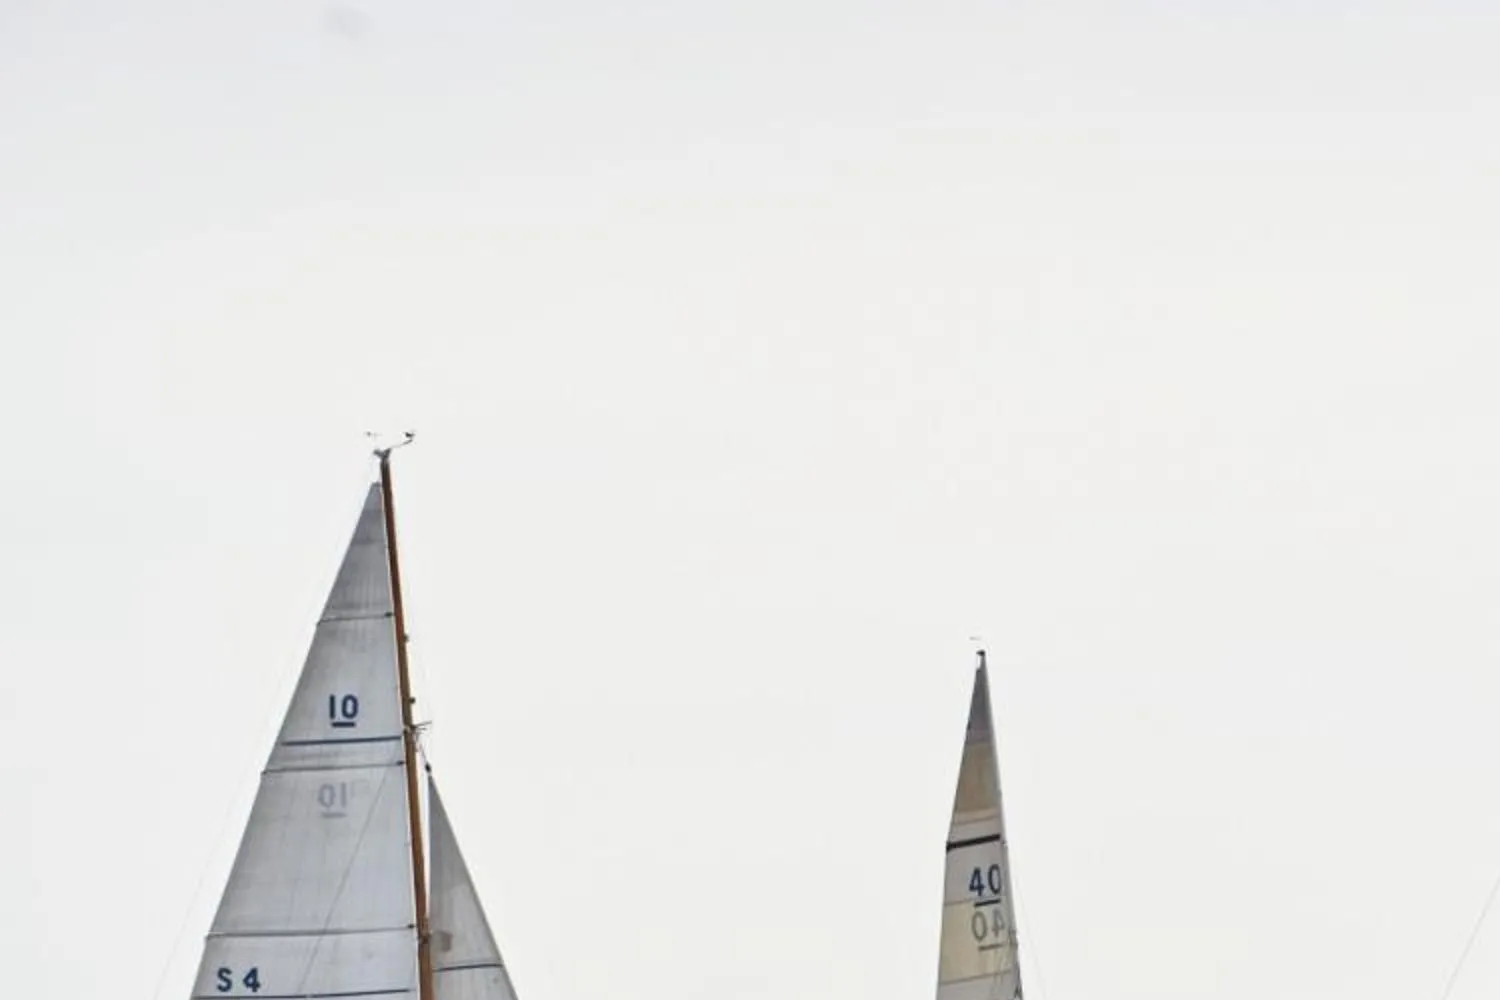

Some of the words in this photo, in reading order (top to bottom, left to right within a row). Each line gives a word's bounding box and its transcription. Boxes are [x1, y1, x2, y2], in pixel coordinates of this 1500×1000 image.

[328, 694, 360, 720] 10
[969, 864, 1001, 896] 40
[216, 968, 233, 993] S
[242, 968, 262, 993] 4
